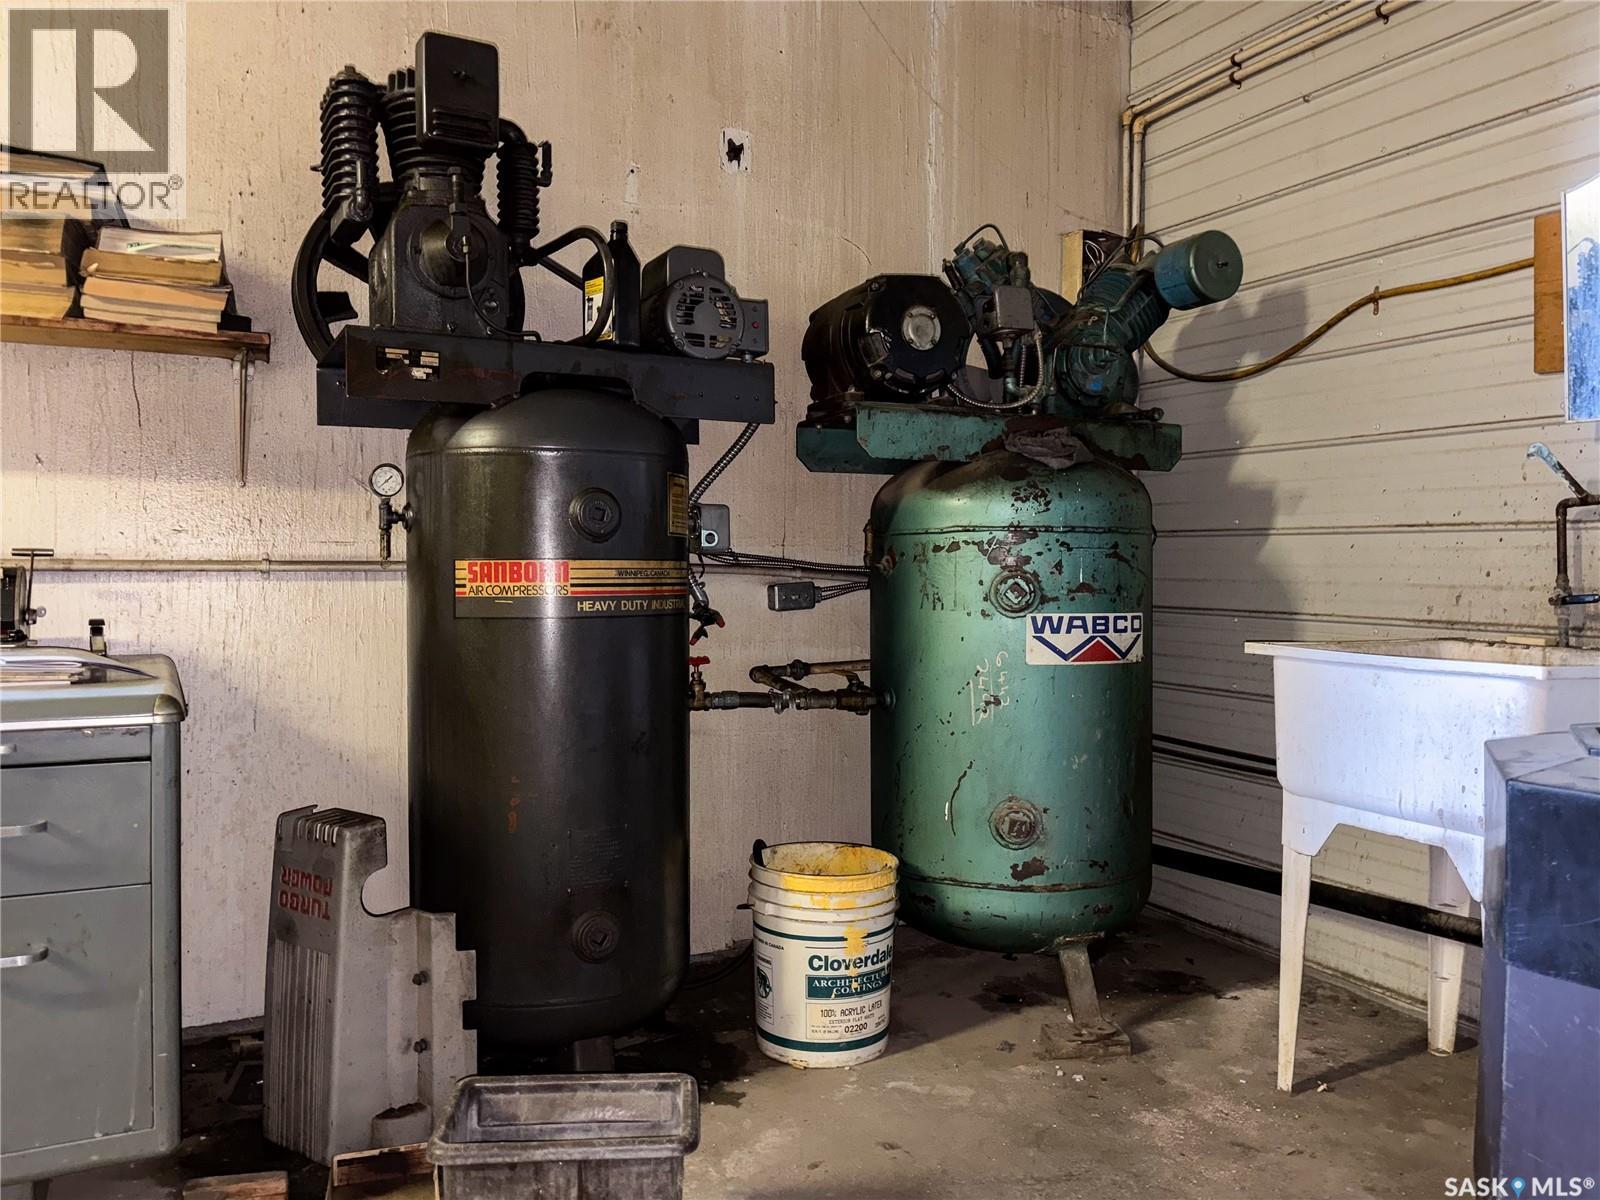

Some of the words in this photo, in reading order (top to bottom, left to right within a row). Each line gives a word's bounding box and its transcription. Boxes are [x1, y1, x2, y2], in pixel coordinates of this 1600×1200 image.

[467, 584, 484, 597] AIR
[485, 584, 570, 597] COMPRESSORS
[577, 600, 617, 612] HEAVY
[621, 599, 649, 611] DUTY
[651, 598, 687, 610] INDUSTRIA
[1030, 614, 1142, 635] WABCO
[279, 864, 333, 898] POWER
[278, 888, 331, 921] TURBO
[807, 943, 895, 972] Cloverdale
[832, 979, 883, 997] COATINGS
[820, 1008, 837, 1018] 100%
[840, 1005, 866, 1017] ACRYLIC
[868, 999, 883, 1012] LATEX
[844, 1022, 868, 1034] 02200
